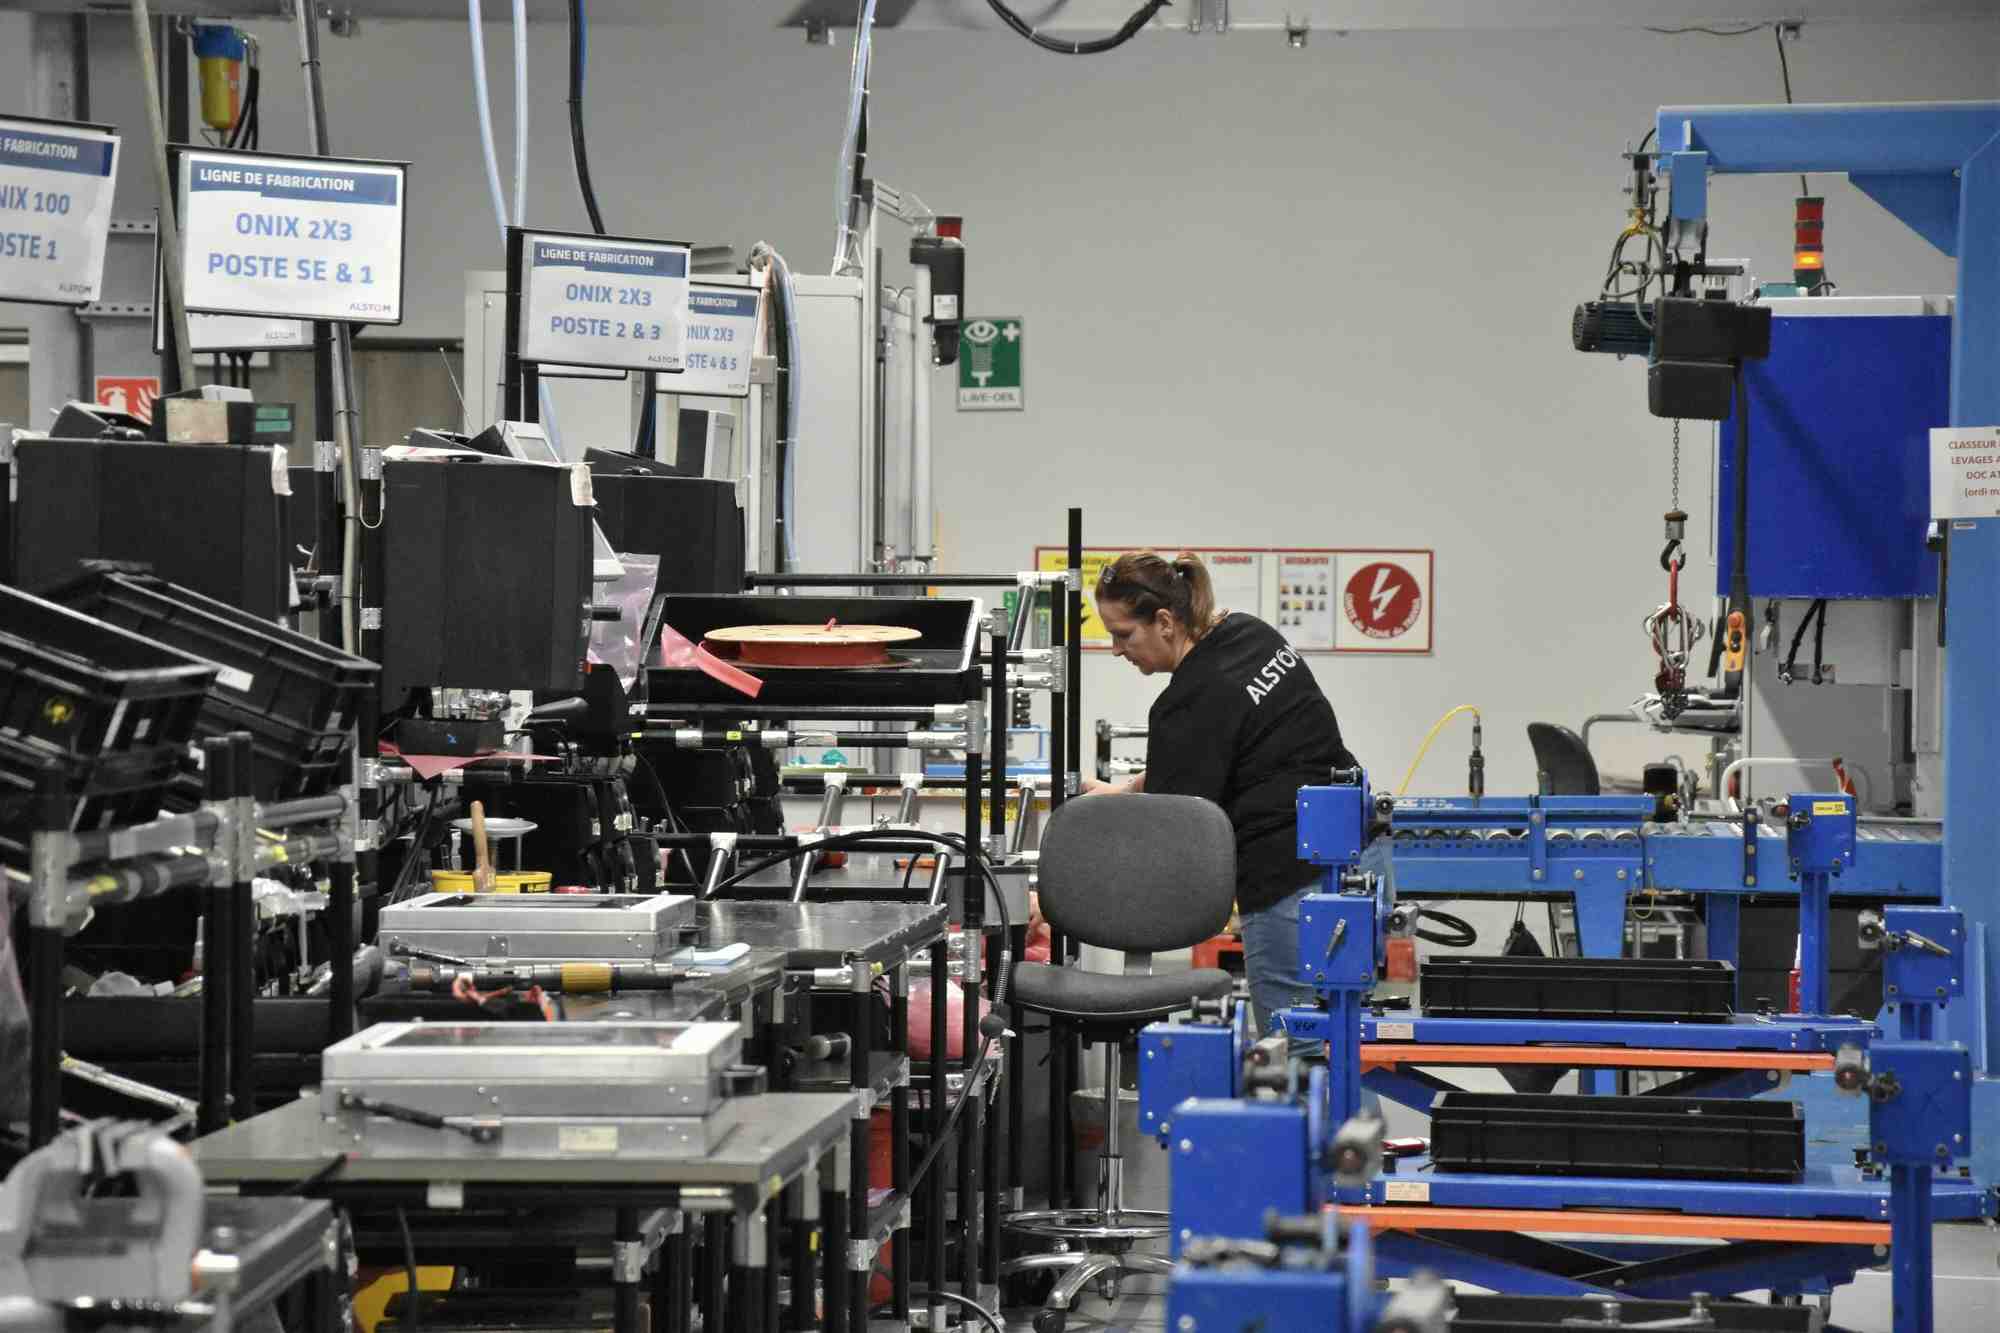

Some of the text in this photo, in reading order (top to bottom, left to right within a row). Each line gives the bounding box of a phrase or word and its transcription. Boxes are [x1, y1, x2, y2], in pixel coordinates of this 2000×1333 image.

[4, 137, 78, 159] FABRICATION
[200, 168, 355, 192] LIGNE DE FABRICATION
[33, 191, 71, 215] 100
[236, 212, 353, 241] ONIX 2X3
[47, 239, 57, 260] 1
[541, 247, 655, 267] LIGNE DE FABRICATION
[208, 252, 374, 284] POSTE SE & 1
[565, 282, 653, 307] ONIX 2X3
[349, 302, 392, 313] ALSTOM
[551, 315, 661, 341] POSTE 2 & 3
[686, 324, 734, 342] NIX 2X3
[686, 352, 709, 370] STE
[709, 356, 718, 369] 4
[719, 355, 729, 370] &
[1948, 440, 1997, 449] CLASSEUR
[1951, 455, 1993, 465] LEVAGES
[1966, 471, 1988, 480] DOC
[1246, 645, 1299, 705] ALSTO
